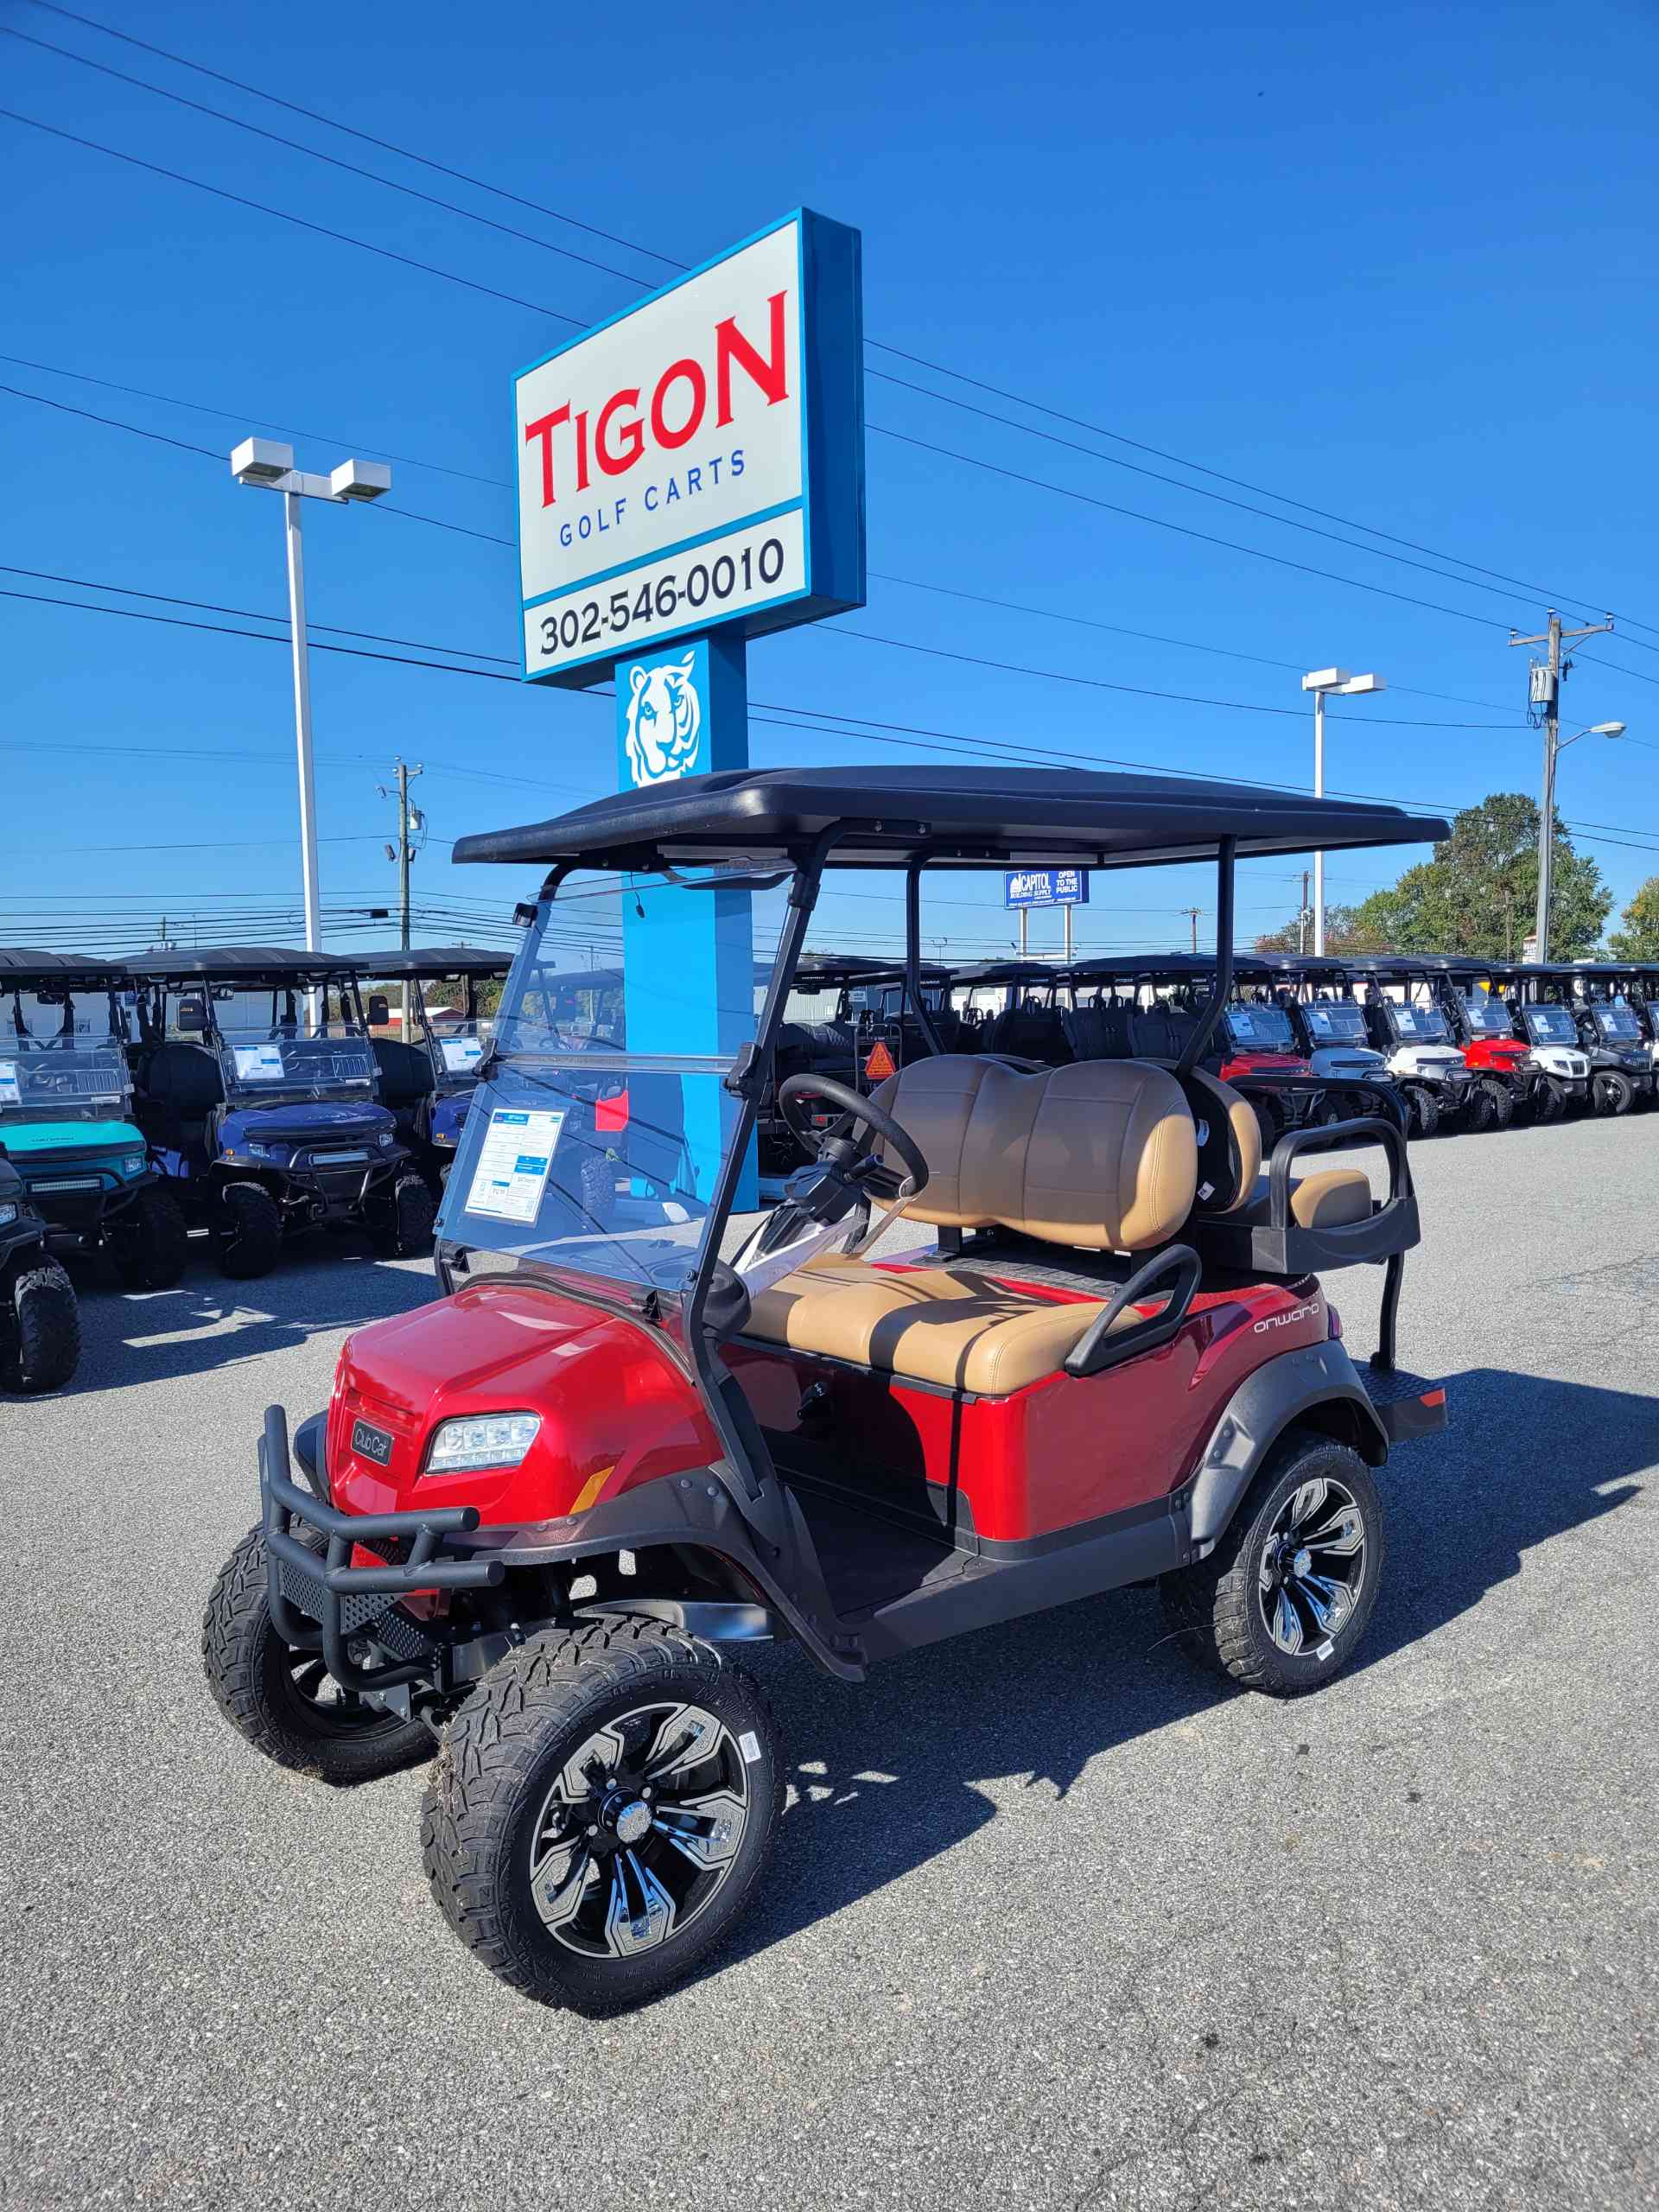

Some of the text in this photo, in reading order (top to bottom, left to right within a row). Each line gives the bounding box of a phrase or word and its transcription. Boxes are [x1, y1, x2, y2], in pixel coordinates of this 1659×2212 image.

[524, 289, 790, 508] TIGON
[559, 449, 746, 547] GOLF CARTS
[540, 538, 785, 655] 302-546-0010
[1021, 873, 1051, 892] CAPITOL
[355, 1428, 387, 1457] Club Car
